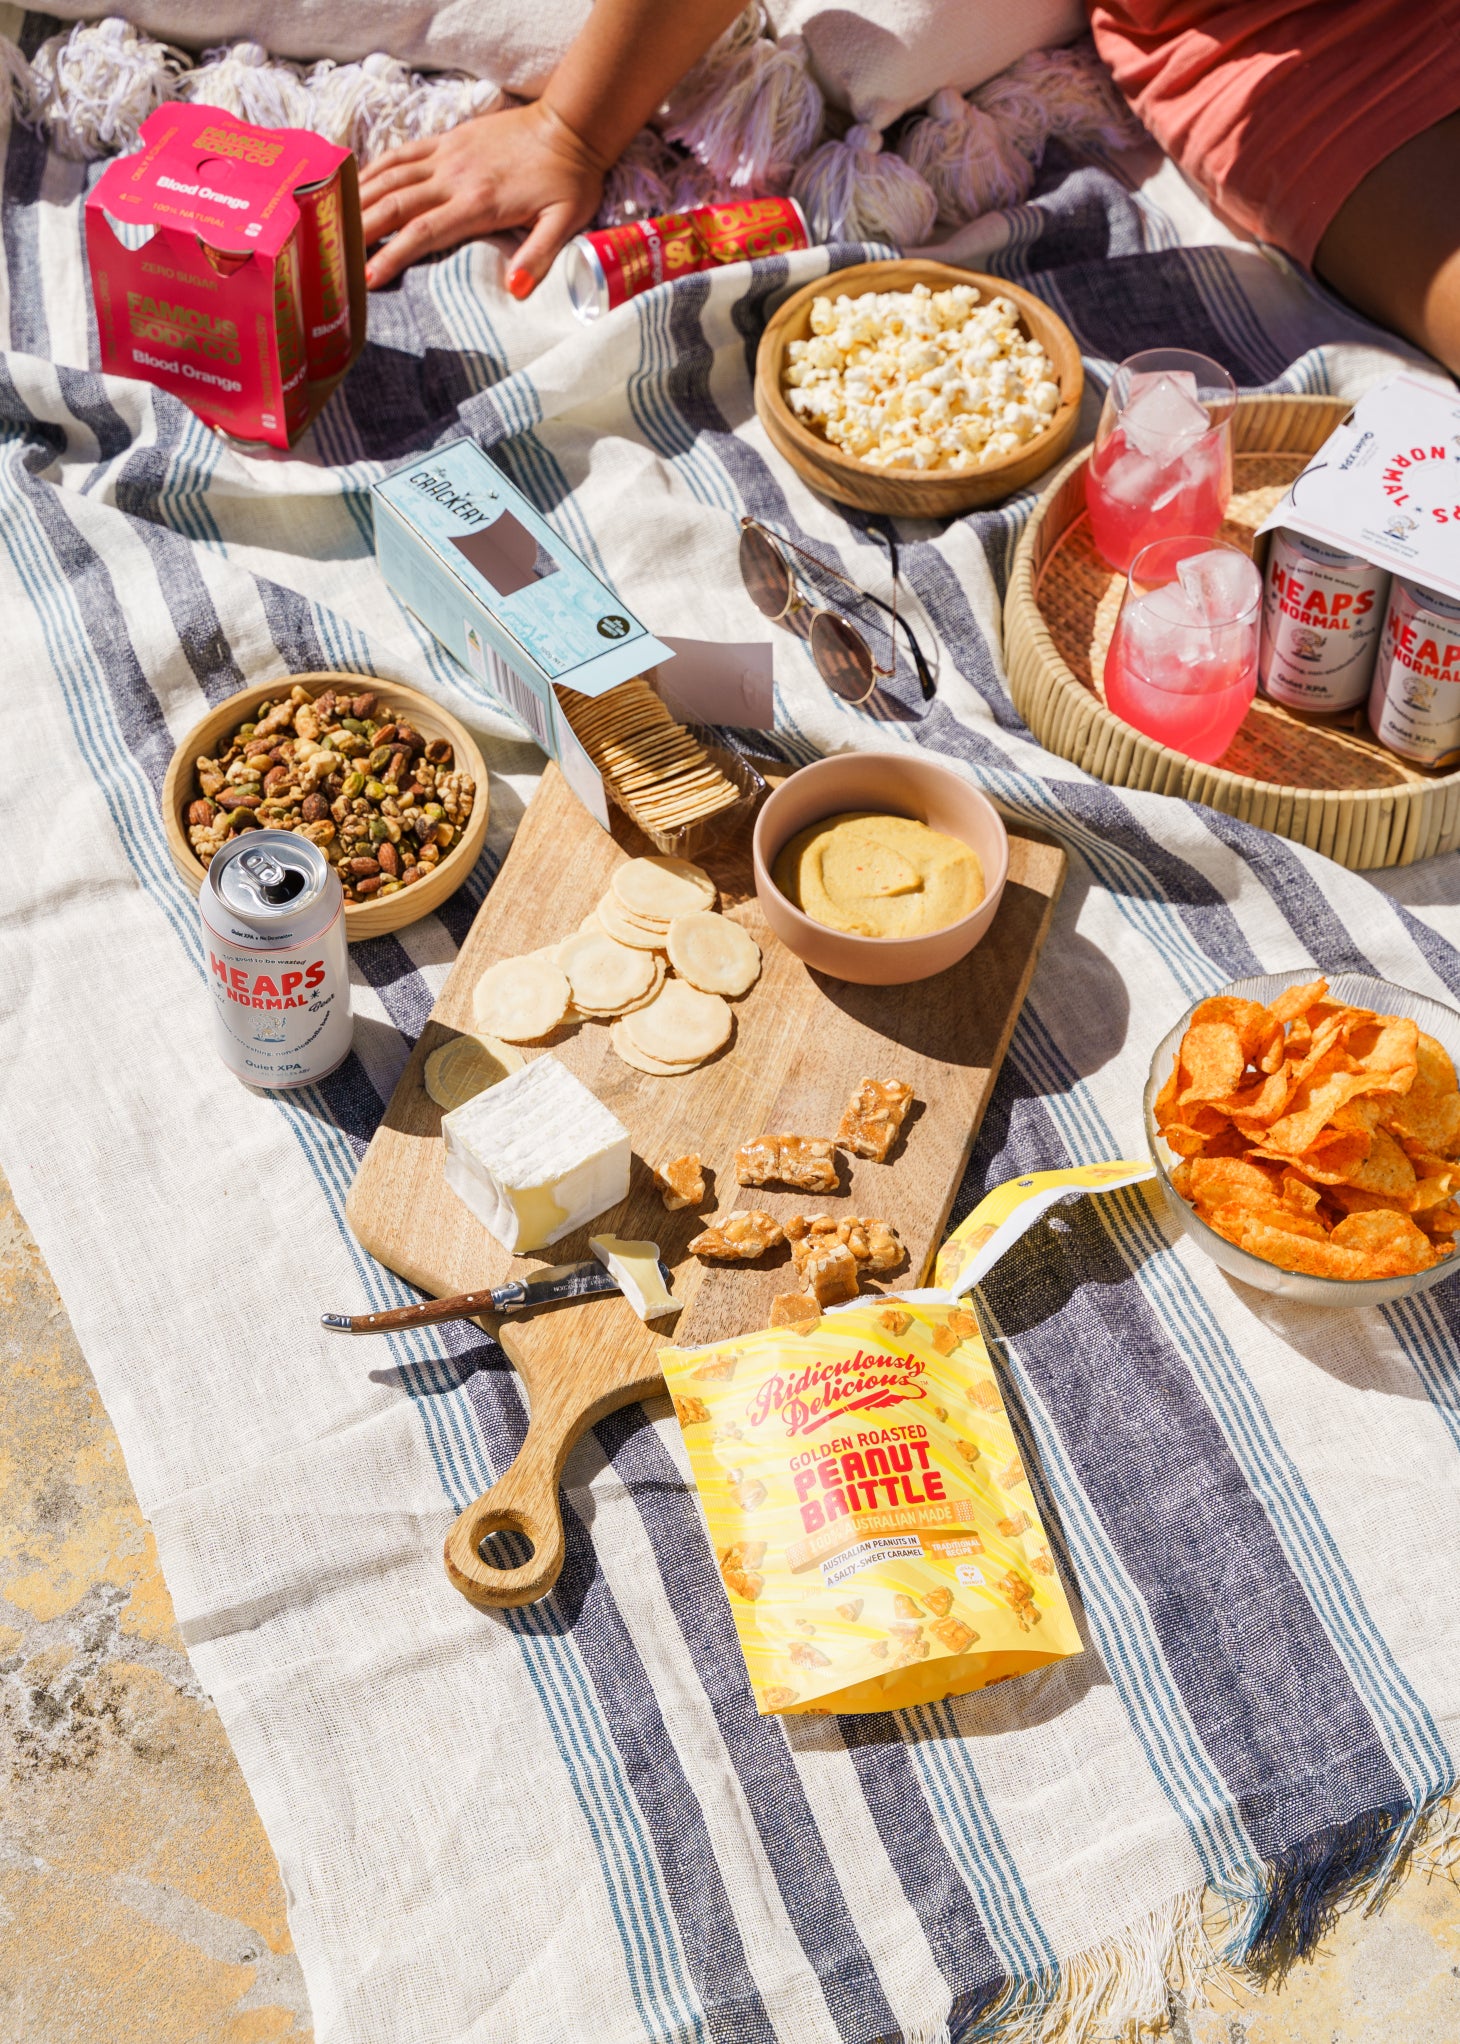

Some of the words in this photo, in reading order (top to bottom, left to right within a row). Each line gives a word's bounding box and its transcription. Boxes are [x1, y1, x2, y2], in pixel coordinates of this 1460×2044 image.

[192, 138, 244, 161] SODA
[245, 152, 275, 167] CO
[200, 126, 284, 157] FAMOUS
[156, 175, 199, 196] Blood
[199, 187, 250, 210] Orange
[178, 208, 226, 228] NATURAL
[746, 226, 795, 257] CO
[141, 262, 175, 280] ZERO
[176, 271, 219, 291] SUGAR
[127, 291, 239, 340] FAMOUS
[130, 318, 201, 354] SODA
[201, 341, 242, 365] CO
[132, 349, 180, 374] Blood
[182, 364, 242, 392] Orange
[1382, 446, 1446, 507] NORMAL
[410, 472, 490, 526] CRACKERY
[1271, 559, 1377, 617] HEAPS
[1279, 597, 1352, 631] NORMAL
[243, 931, 255, 940] XPA
[210, 950, 326, 997] HEAPS
[226, 986, 309, 1011] NORMAL
[245, 1059, 275, 1071] Quiet
[276, 1062, 303, 1072] XPA
[746, 1350, 931, 1427] Ridiculously
[782, 1371, 912, 1437] Delicious
[789, 1435, 853, 1472] GOLDEN
[857, 1424, 928, 1447] ROASTED
[793, 1440, 931, 1503] PEANUT
[799, 1471, 947, 1535] BRITTLE
[843, 1512, 917, 1537] AUSTRALIAN
[918, 1505, 953, 1524] MADE
[823, 1542, 872, 1573] AUSTRALIAN
[872, 1536, 907, 1549] PEANUTS
[907, 1536, 917, 1545] IN
[932, 1538, 981, 1551] TRADITIONAL
[945, 1547, 973, 1557] RECIPE
[826, 1576, 835, 1587] A
[834, 1552, 886, 1583] SALTY-SWEET
[887, 1548, 923, 1560] CARAMEL
